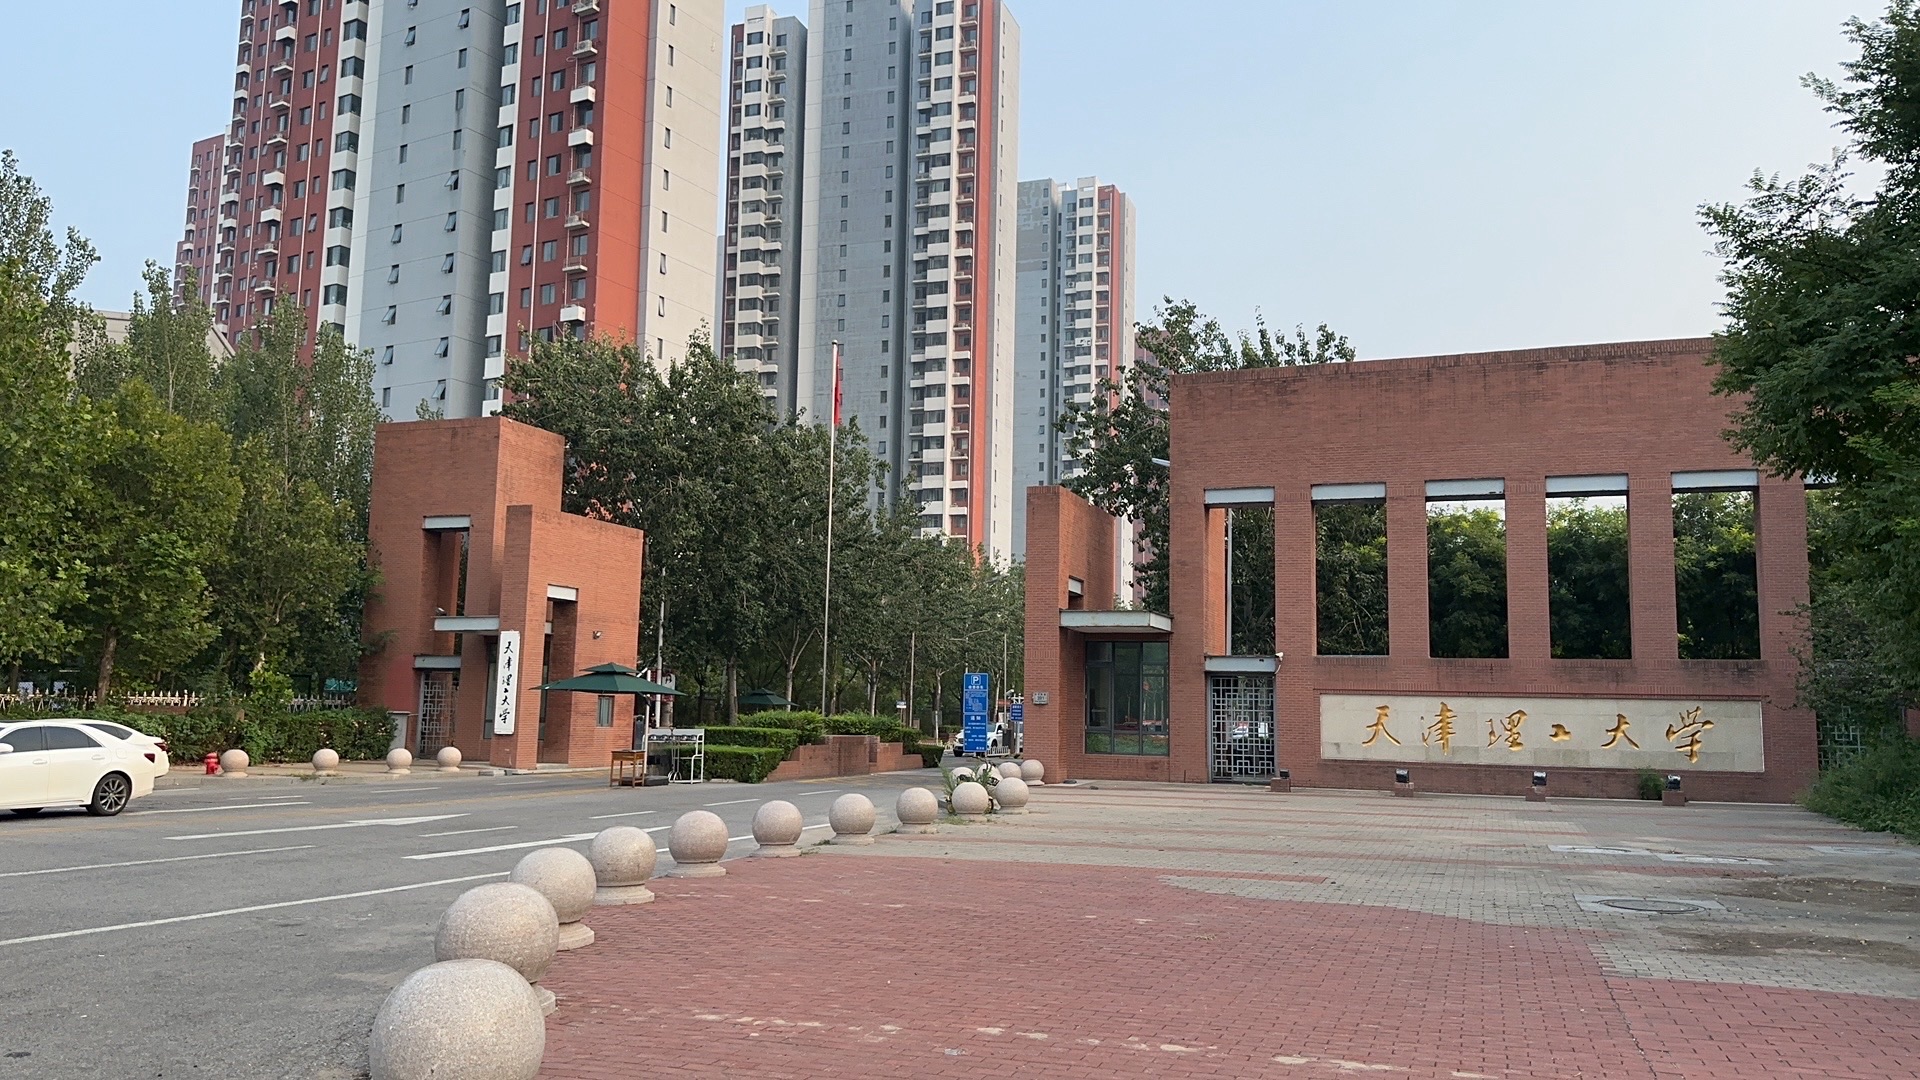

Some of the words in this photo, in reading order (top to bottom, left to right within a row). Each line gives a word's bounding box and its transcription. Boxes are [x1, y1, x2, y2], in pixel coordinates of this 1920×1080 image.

[499, 641, 514, 724] 天津理工大学
[1362, 702, 1714, 763] 天津理工大学
